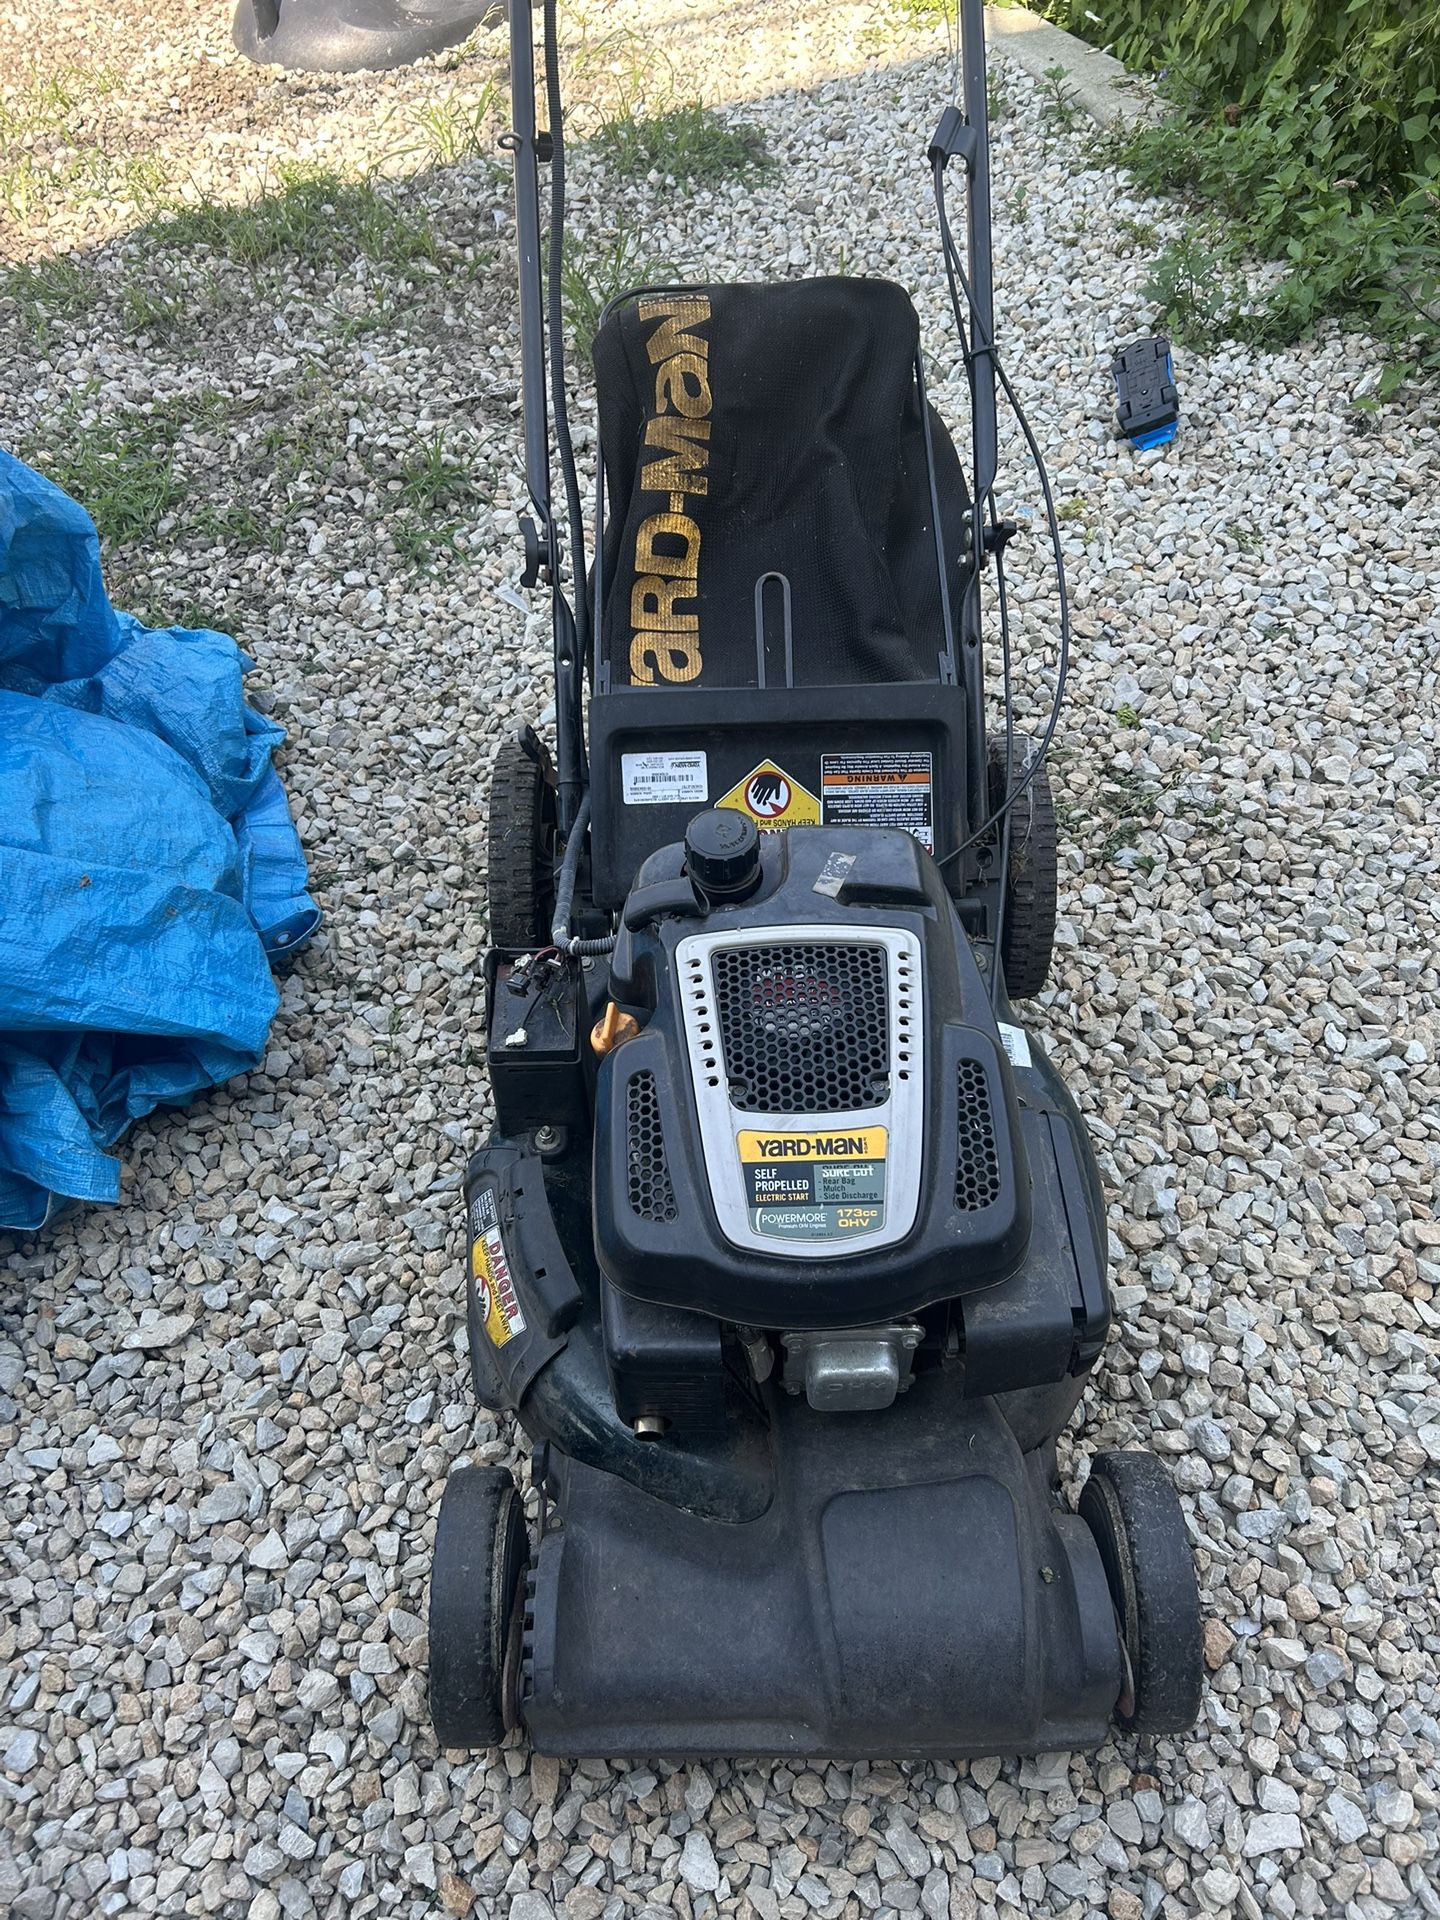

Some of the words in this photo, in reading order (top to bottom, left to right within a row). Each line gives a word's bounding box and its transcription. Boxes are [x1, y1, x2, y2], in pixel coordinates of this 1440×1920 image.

[629, 300, 713, 686] aRD-MaN
[754, 1168, 777, 1179] SELF
[756, 1180, 809, 1191] PROPELLED
[756, 1193, 787, 1202] ELECTRIC
[842, 1192, 878, 1200] Discharge
[762, 1212, 826, 1224] POWERMORE
[837, 1209, 878, 1217] 173cc
[838, 1218, 869, 1227] OHV
[488, 1240, 519, 1320] DANGER
[481, 1240, 489, 1257] KEEP
[485, 1257, 495, 1282] HANDS
[493, 1293, 504, 1314] FEET
[500, 1312, 511, 1336] AWAY
